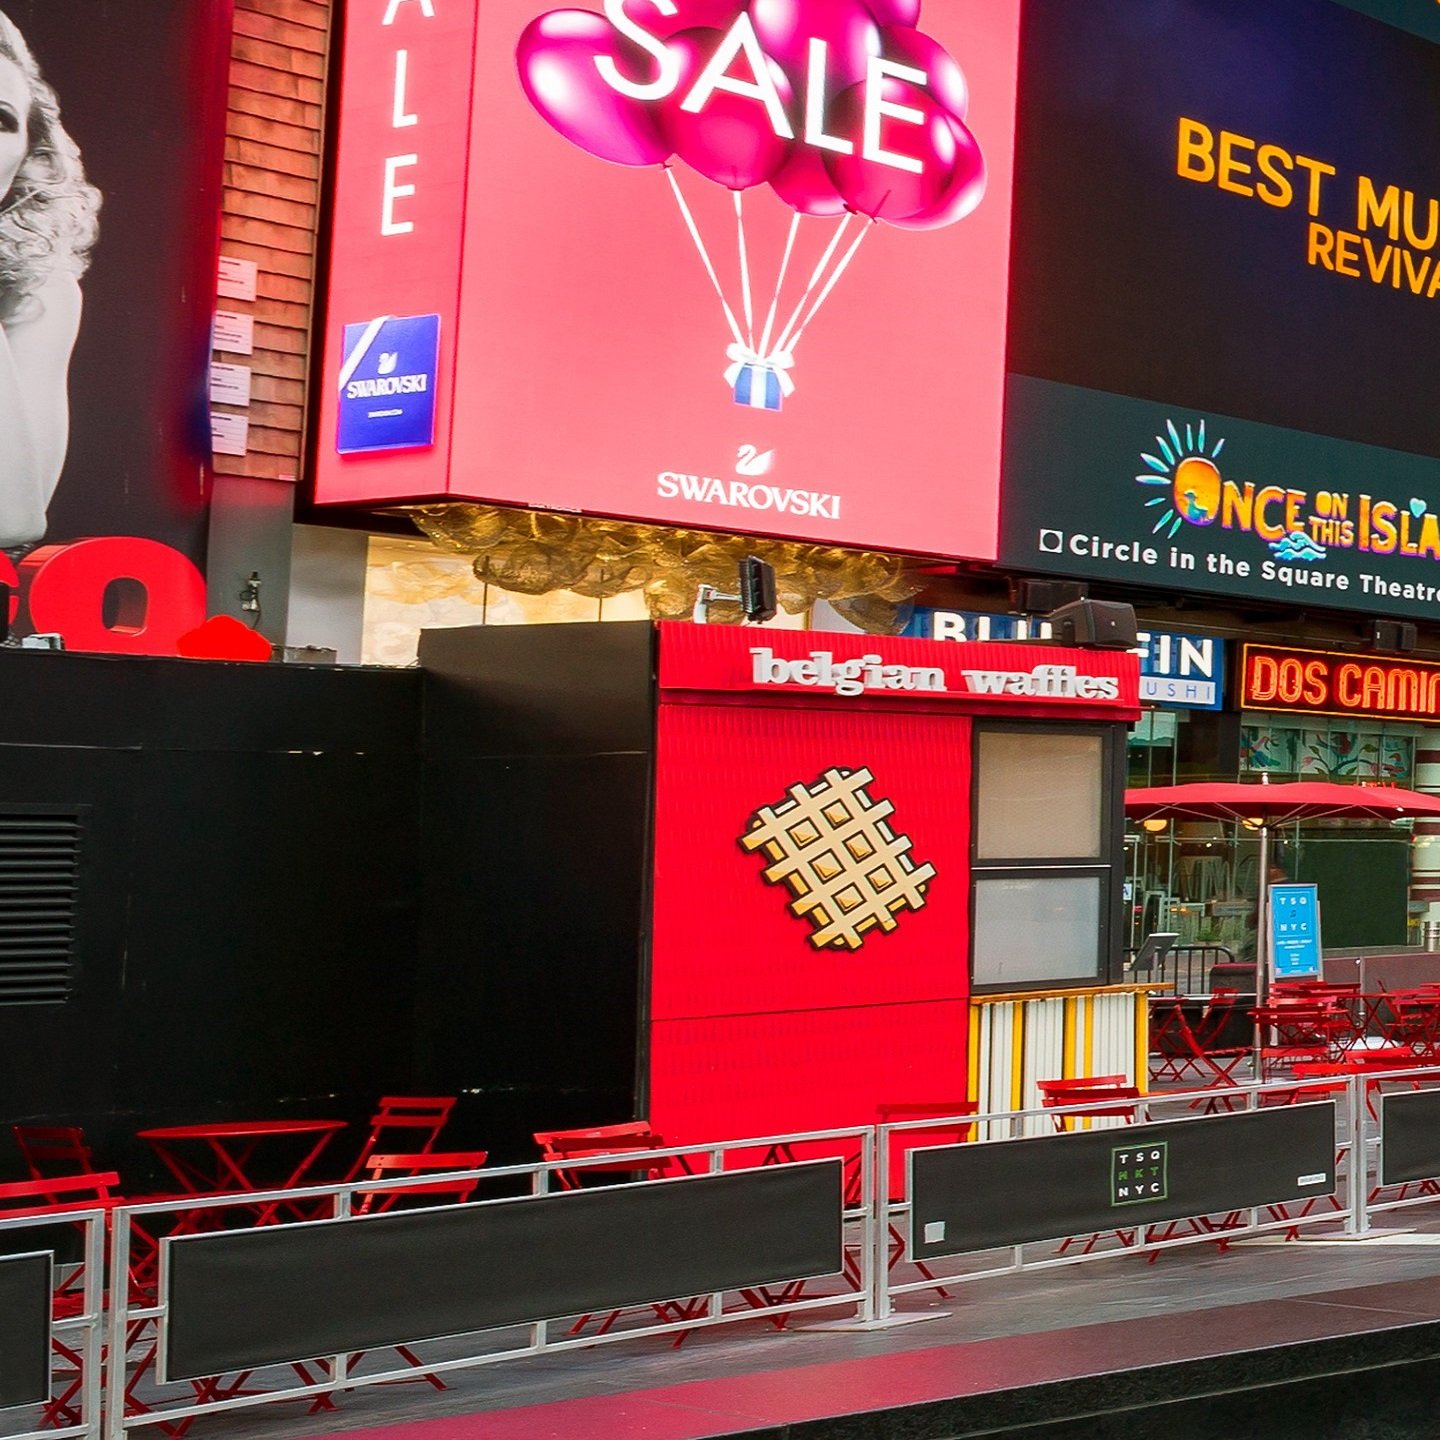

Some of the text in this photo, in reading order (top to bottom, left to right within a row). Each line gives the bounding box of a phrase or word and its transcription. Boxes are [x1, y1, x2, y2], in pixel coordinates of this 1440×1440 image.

[1177, 116, 1336, 216] BEST
[347, 373, 427, 401] SWAROVSKI
[657, 471, 841, 520] SWAROVSKI
[1172, 457, 1306, 542] ONCE
[1315, 490, 1348, 520] ON
[1308, 515, 1354, 547] THIS
[1069, 533, 1158, 565] Circle
[1170, 547, 1195, 571] in
[1206, 553, 1250, 578] the
[1261, 560, 1350, 591] Square
[750, 648, 1120, 700] belgian waffles
[1252, 656, 1327, 704] DOS
[1119, 1149, 1161, 1165] TSQ
[1118, 1182, 1160, 1198] NYC
